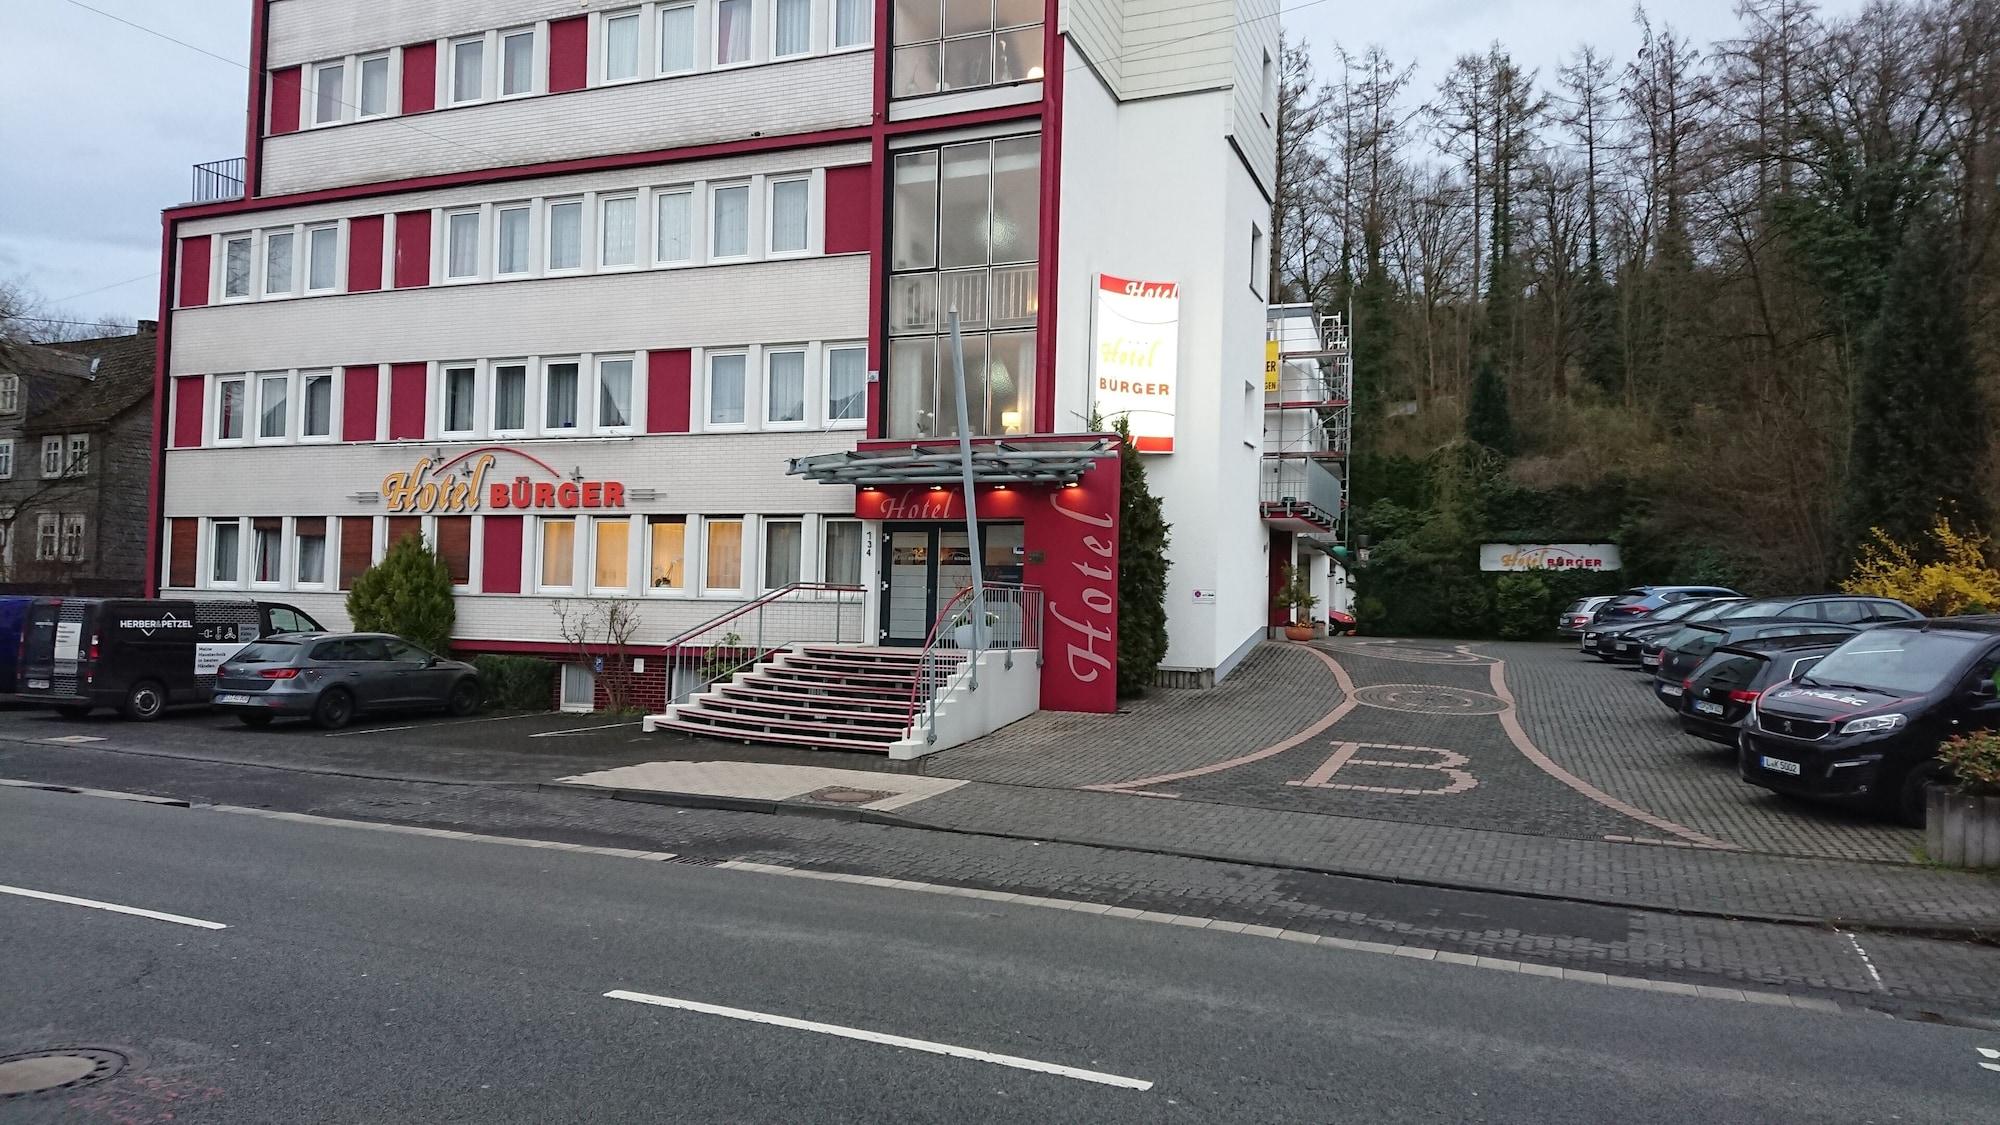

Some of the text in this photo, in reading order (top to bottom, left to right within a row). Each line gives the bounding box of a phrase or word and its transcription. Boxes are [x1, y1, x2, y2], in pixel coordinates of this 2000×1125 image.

[1125, 281, 1178, 299] Hotel
[1101, 337, 1162, 368] Hotel
[382, 454, 625, 512] Hotel BÜRGER
[880, 488, 959, 519] Hotel
[1502, 546, 1548, 567] Hotel
[1050, 494, 1114, 683] Hotel
